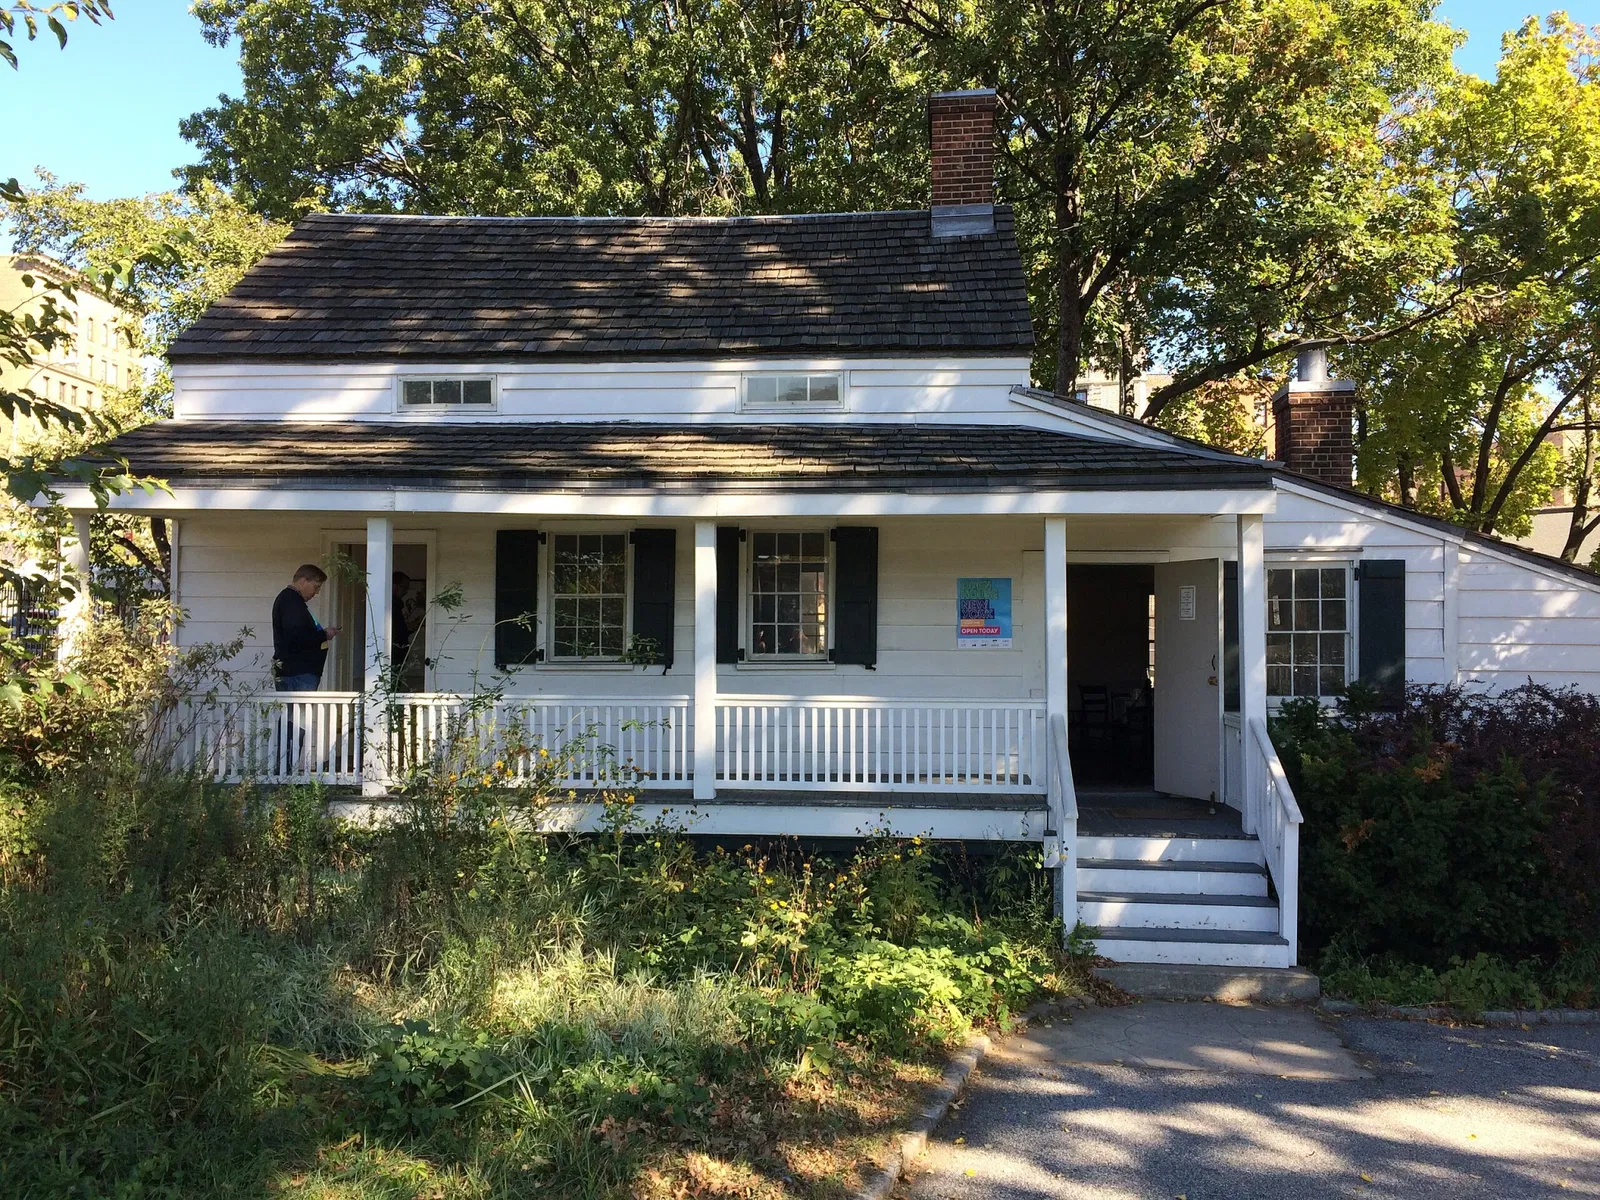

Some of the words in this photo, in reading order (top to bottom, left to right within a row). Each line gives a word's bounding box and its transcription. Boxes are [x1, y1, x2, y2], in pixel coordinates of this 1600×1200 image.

[961, 581, 992, 590] OPEN
[961, 600, 989, 609] NEW
[961, 609, 994, 619] YORK
